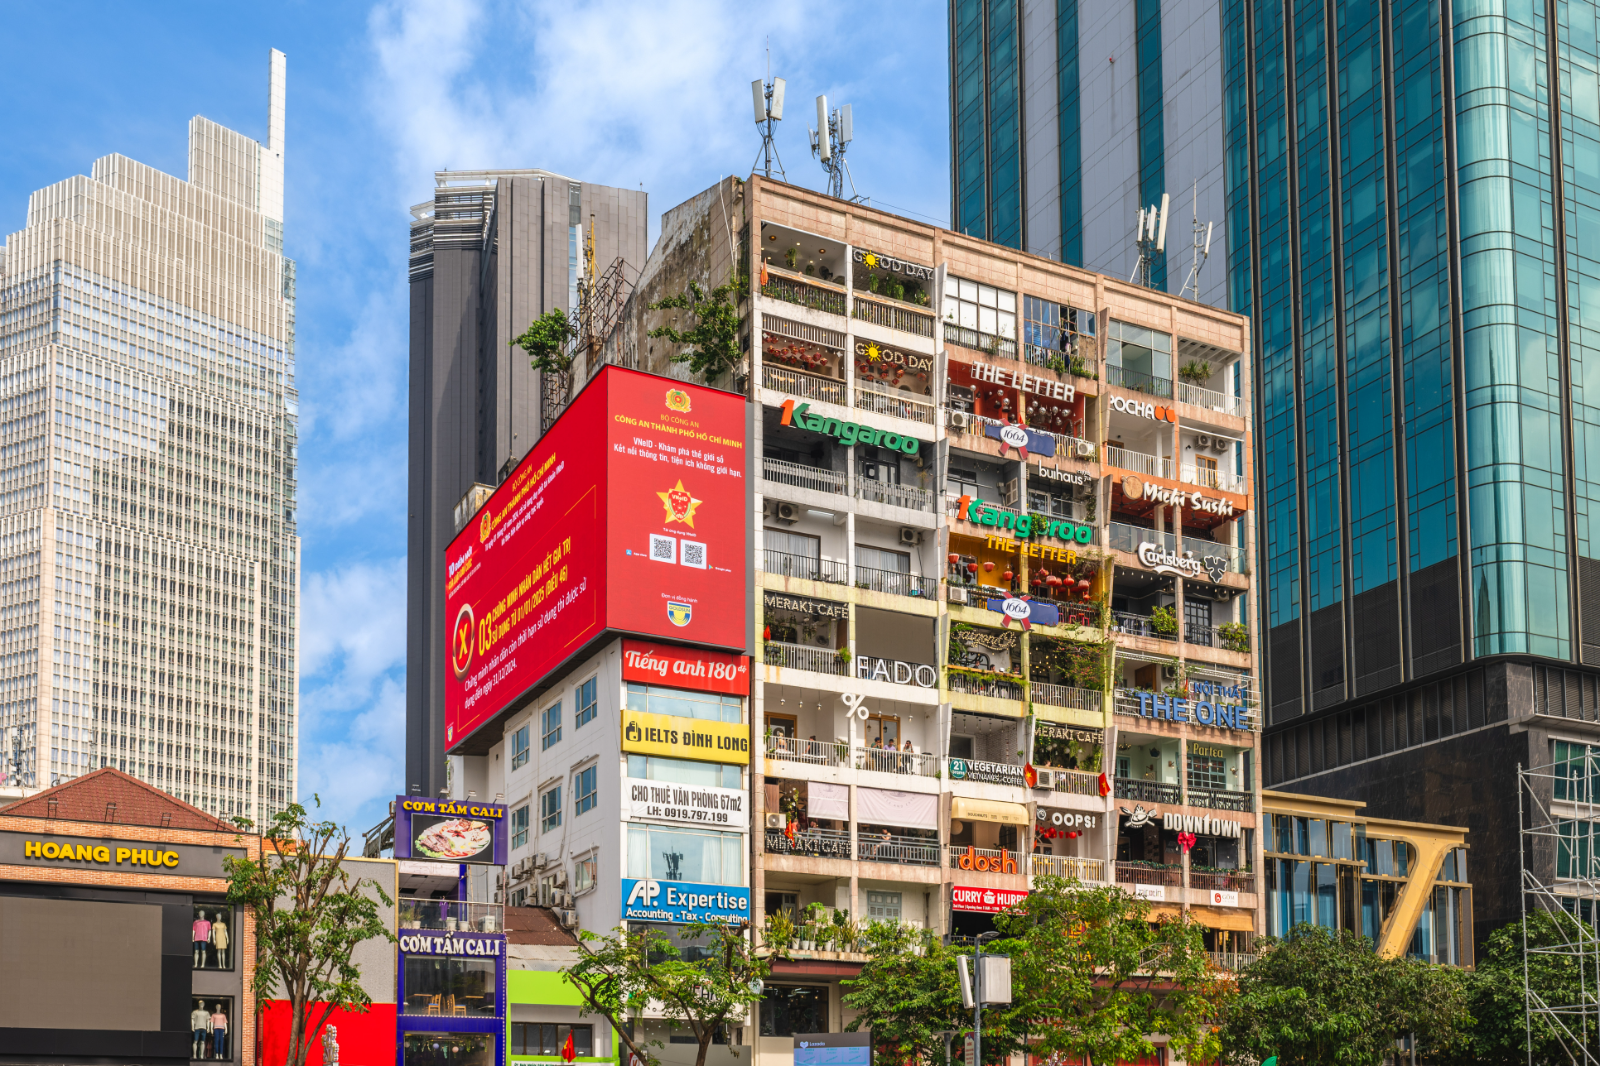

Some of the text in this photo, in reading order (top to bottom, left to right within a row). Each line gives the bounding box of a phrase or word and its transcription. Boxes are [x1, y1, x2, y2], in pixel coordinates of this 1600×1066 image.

[906, 262, 933, 280] DAY
[908, 356, 933, 372] DAY
[972, 360, 1075, 403] THE LETTER
[614, 414, 637, 425] CÔNG
[638, 420, 650, 428] AN
[651, 422, 678, 434] THÀNH
[679, 428, 695, 438] PHỐ
[709, 435, 721, 444] CHÍ
[723, 438, 742, 449] MINH
[1004, 430, 1025, 442] 1664
[614, 443, 625, 453] Kết
[633, 437, 653, 448] VNeID
[659, 442, 676, 453] Khám
[1144, 482, 1233, 516] Michi Sushi
[986, 534, 1077, 564] THE LETTER
[1138, 541, 1200, 575] Carlsberg
[492, 598, 506, 622] CHỨNG
[507, 587, 518, 608] MINH
[519, 574, 531, 597] NHÂN
[532, 564, 542, 584] DÂN
[764, 595, 813, 614] MERAKI
[1006, 603, 1027, 614] 1664
[479, 612, 492, 656] 03
[626, 650, 746, 680] Tiếng anh 180 độ
[857, 656, 936, 688] FADO
[1194, 680, 1246, 699] NỘI THẤT
[1135, 692, 1249, 730] THE ONE
[645, 727, 748, 752] IELTS ĐÌNH LONG
[1034, 727, 1073, 741] MERAKI
[1193, 742, 1224, 758] Partea
[953, 761, 963, 770] 21
[967, 761, 1023, 776] VEGETARIAN
[632, 785, 742, 811] CHO THUÊ VĂN PHÒNG 67m2
[402, 800, 503, 818] CƠM TẤM CALI
[647, 806, 728, 822] LH: 0919.797.199
[1052, 812, 1096, 828] OOPS!
[25, 840, 179, 867] HOANG PHUC
[959, 845, 1017, 874] dosh
[667, 887, 747, 910] Expertise
[953, 890, 982, 903] CURRY
[626, 908, 748, 924] Accounting Tax Consulting
[400, 930, 500, 956] CƠM TẤM CALI
